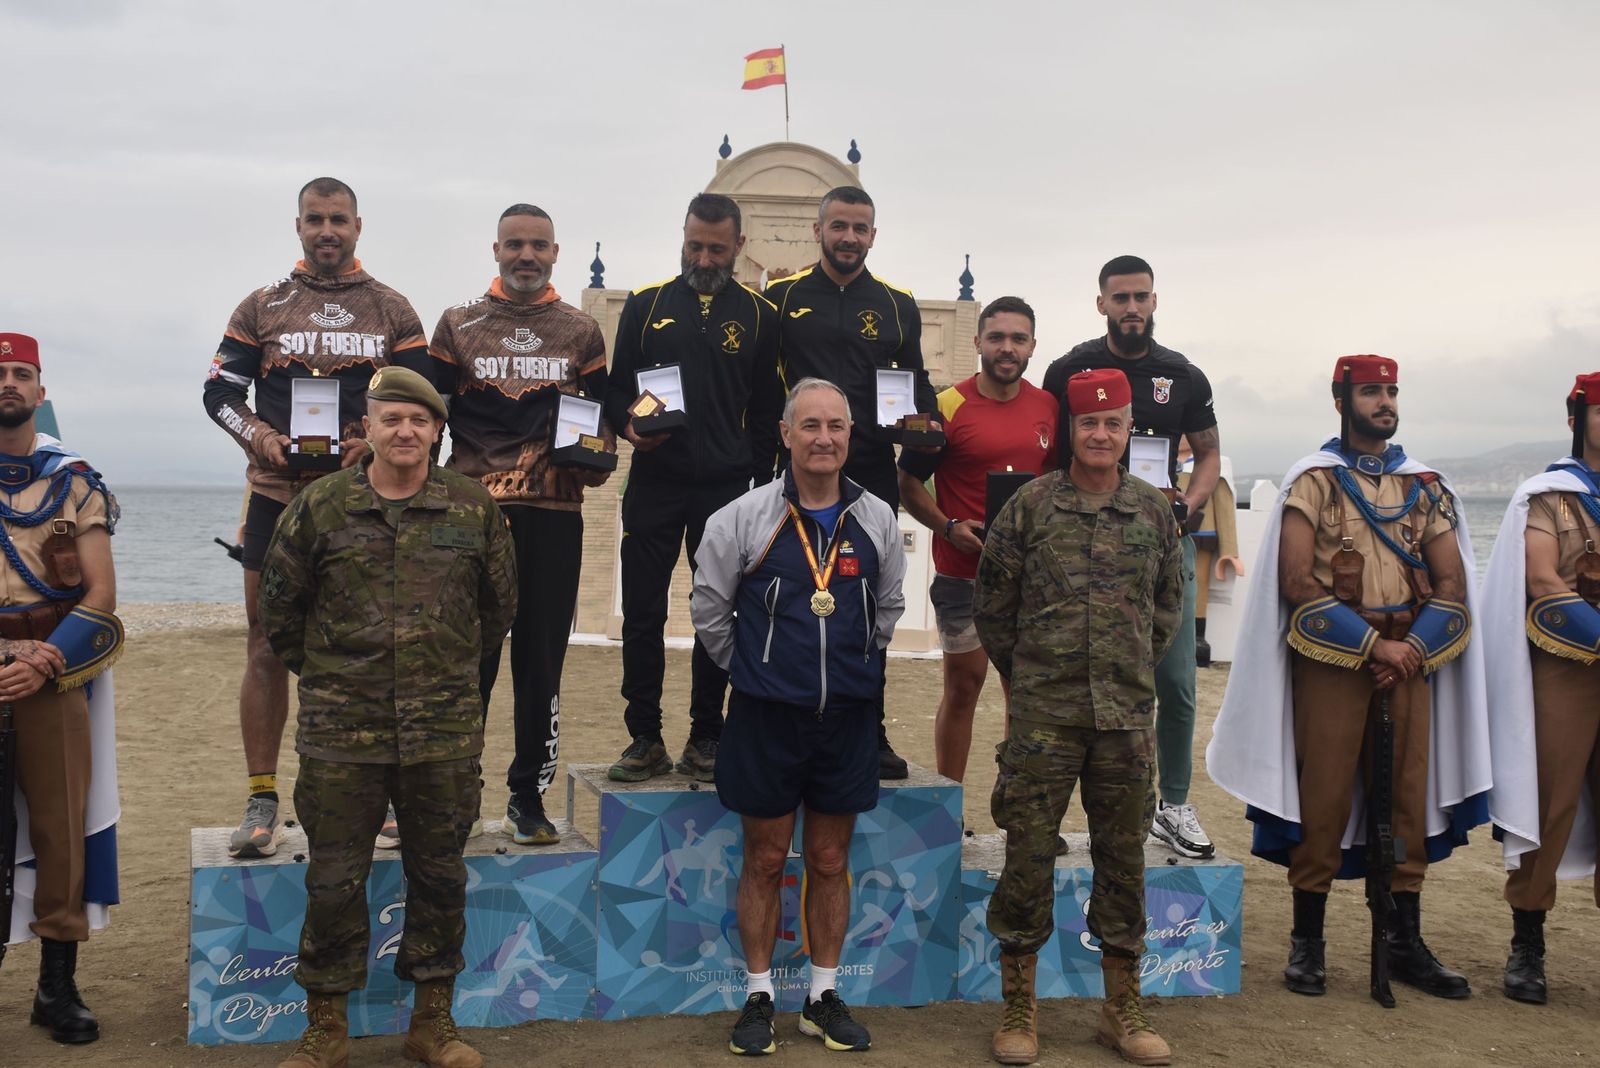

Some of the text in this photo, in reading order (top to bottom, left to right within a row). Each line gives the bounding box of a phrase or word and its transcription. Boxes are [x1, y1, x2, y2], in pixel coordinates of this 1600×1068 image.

[312, 314, 353, 326] TRAIL RACE
[278, 331, 385, 359] SOY FUERTE
[504, 337, 541, 351] TRAIL RACE
[474, 355, 570, 381] SOY FUERTE
[1206, 920, 1229, 934] es
[219, 954, 300, 985] Ceuta
[769, 965, 788, 979] UTÍ
[791, 967, 807, 979] DE
[836, 964, 875, 976] ORTES
[1139, 949, 1230, 986] Deporte
[223, 996, 309, 1032] Depor
